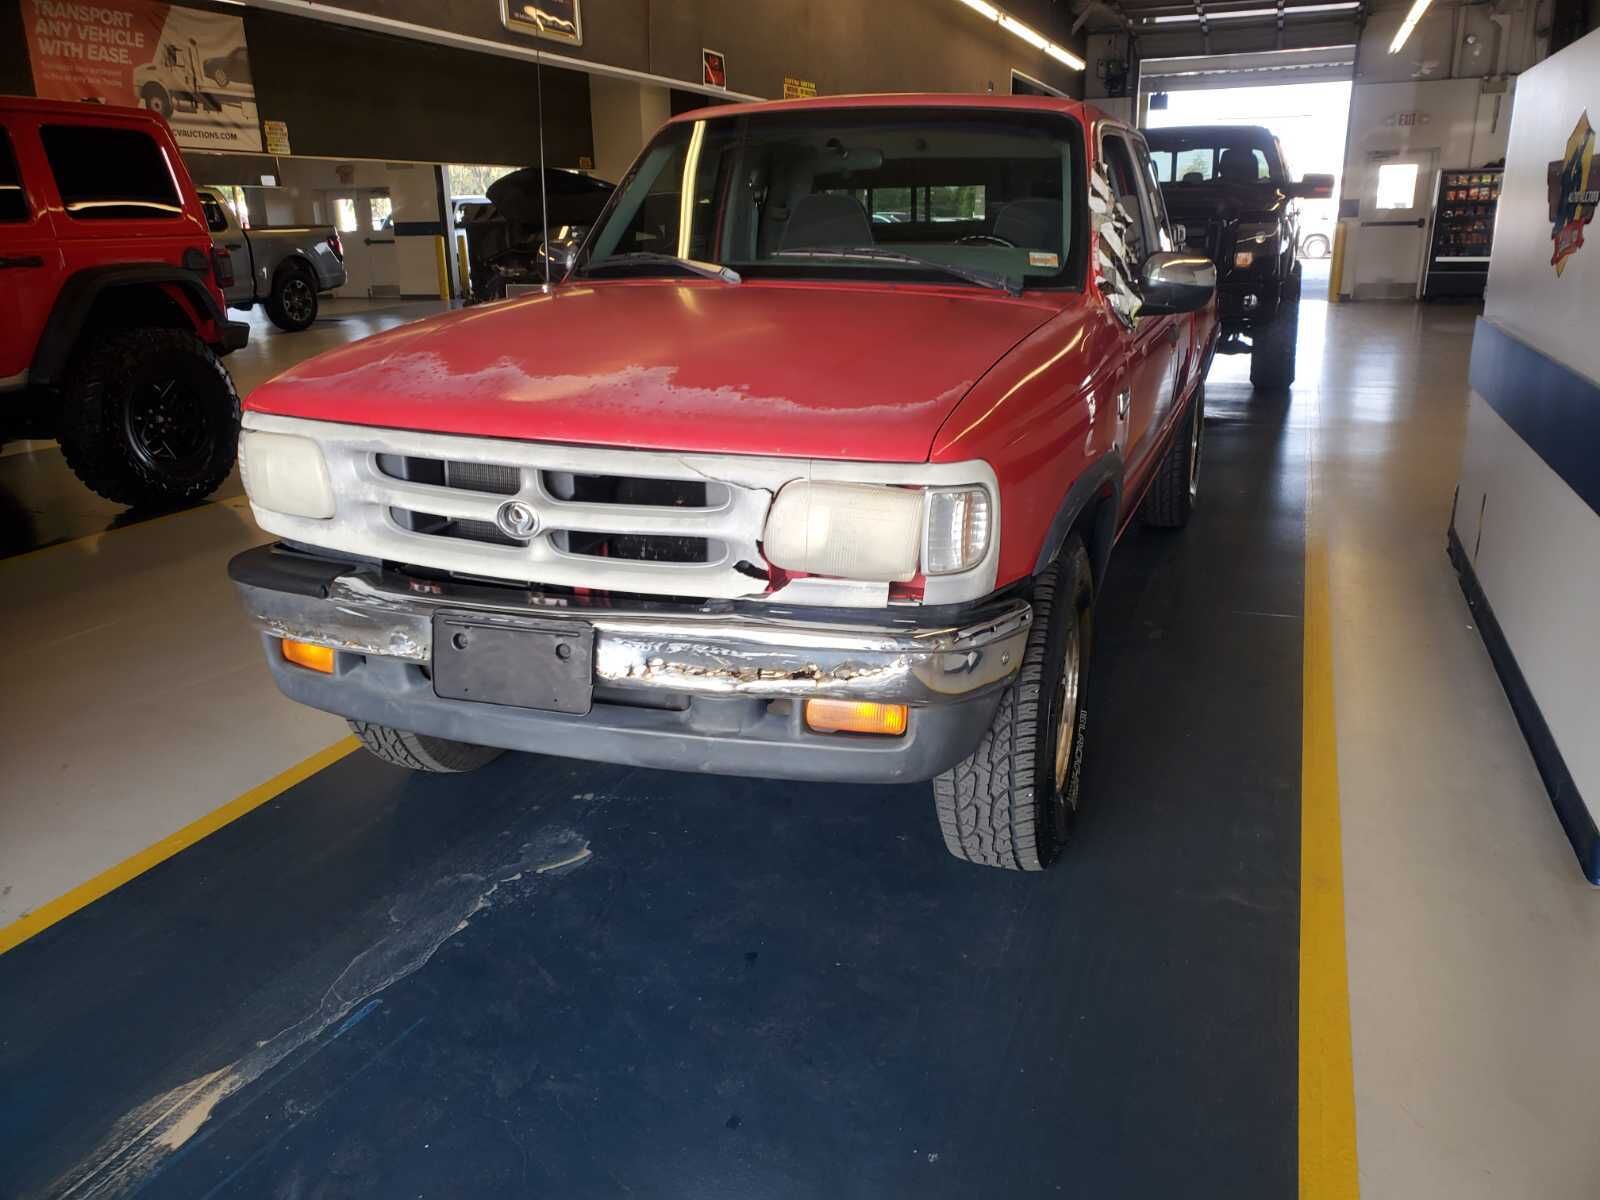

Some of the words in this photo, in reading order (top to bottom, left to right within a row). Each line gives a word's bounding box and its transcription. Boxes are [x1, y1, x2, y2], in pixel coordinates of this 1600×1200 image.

[32, 0, 133, 28] TRANSPORT
[35, 18, 73, 38] ANY
[79, 25, 145, 48] VEHICLE
[38, 38, 83, 58] WITH
[87, 43, 132, 65] EASE.
[1398, 112, 1417, 127] EXIT
